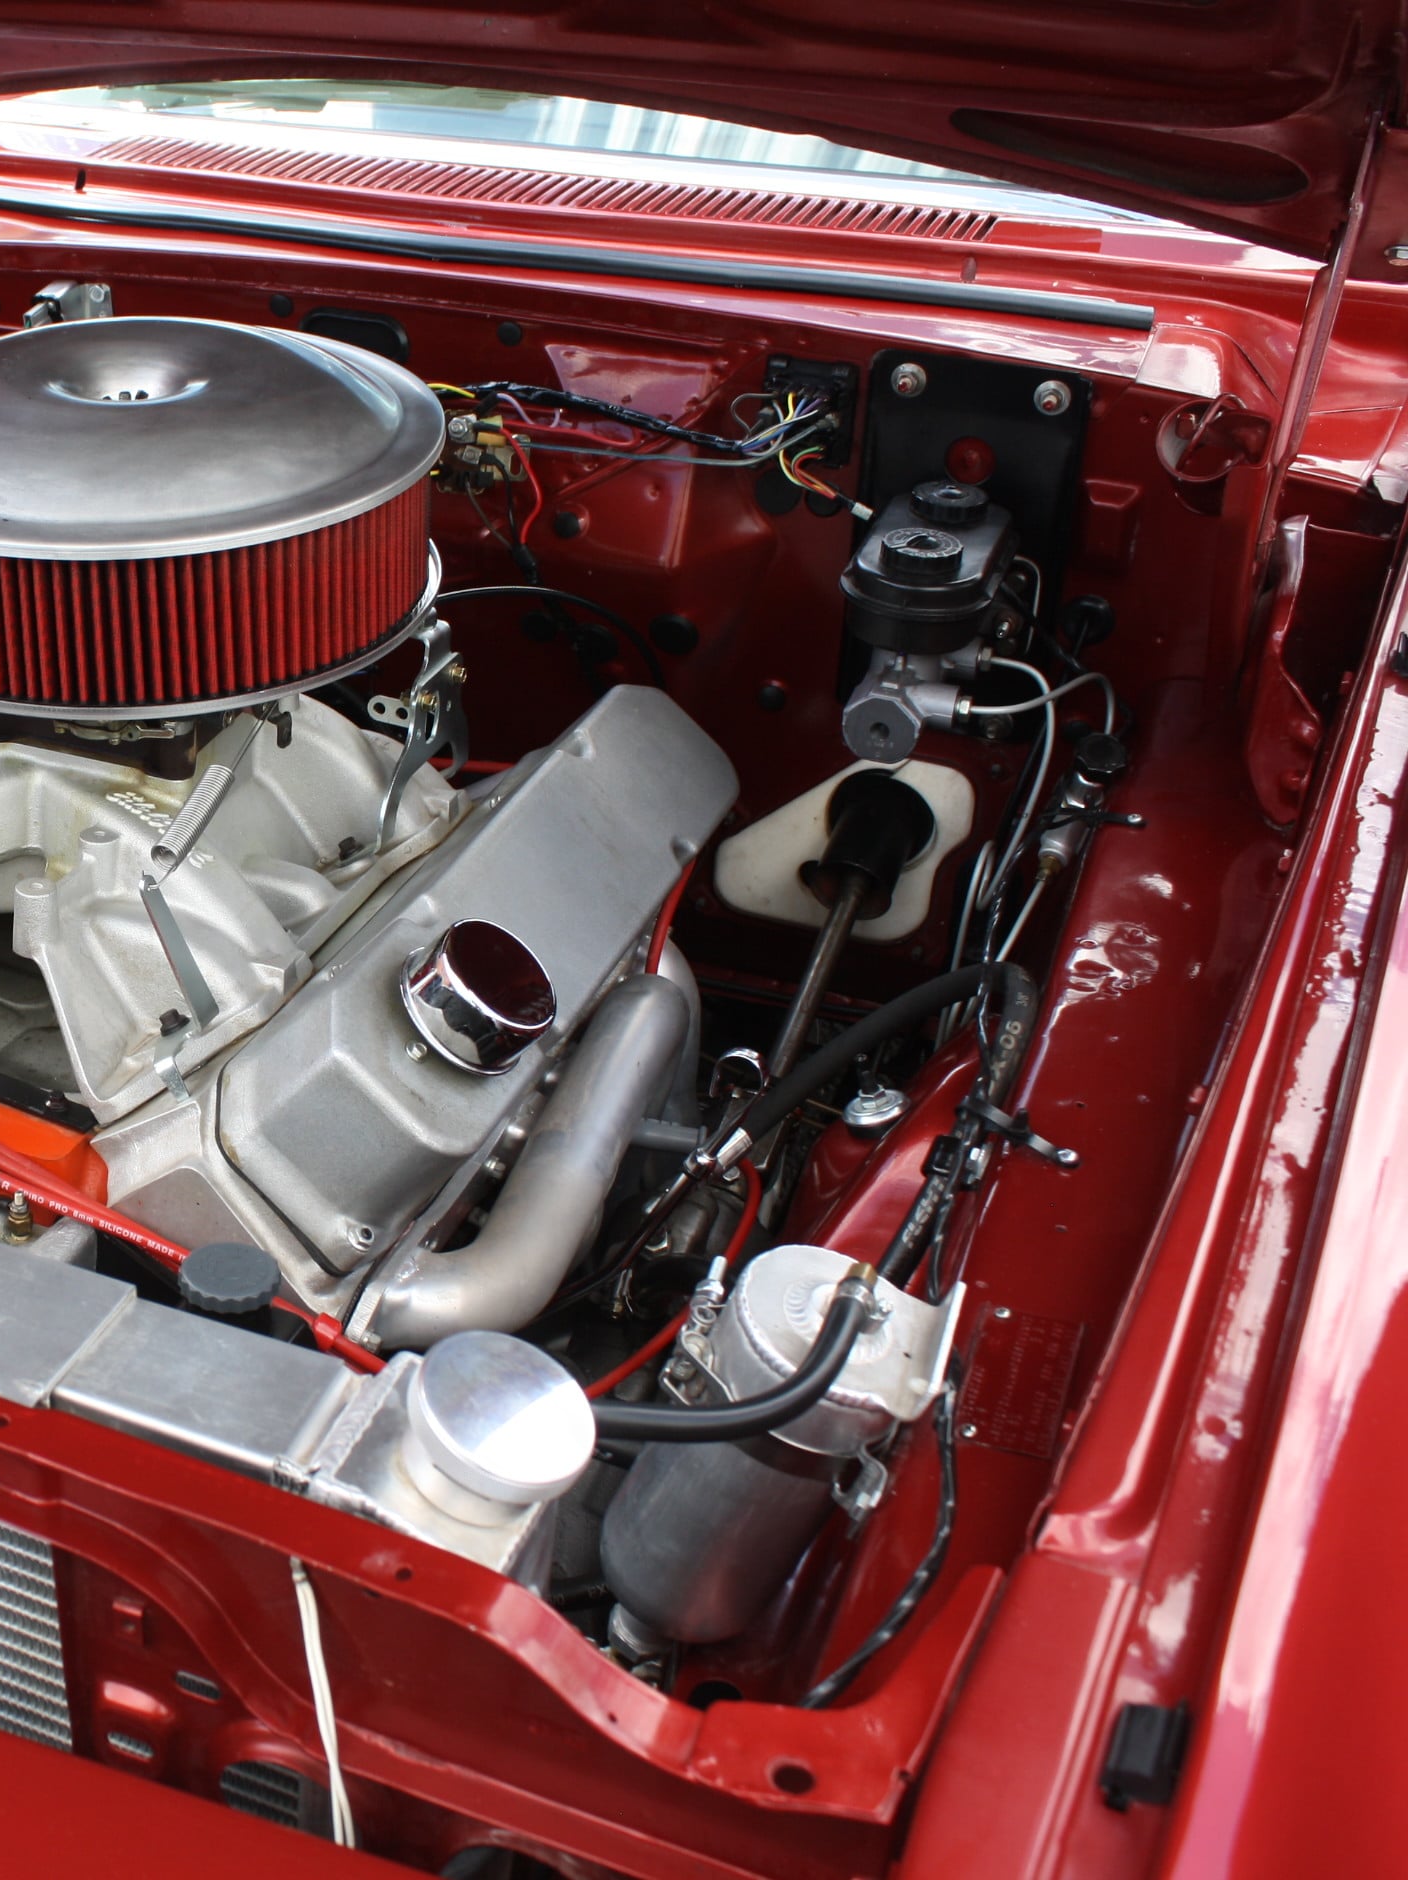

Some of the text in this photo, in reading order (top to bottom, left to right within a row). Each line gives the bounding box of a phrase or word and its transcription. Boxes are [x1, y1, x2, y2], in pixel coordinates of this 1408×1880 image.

[18, 1188, 44, 1204] PIRO
[48, 1200, 69, 1214] PRO
[72, 1209, 94, 1223] 8mm
[99, 1219, 143, 1242] SILICONE
[147, 1239, 175, 1257] MADE
